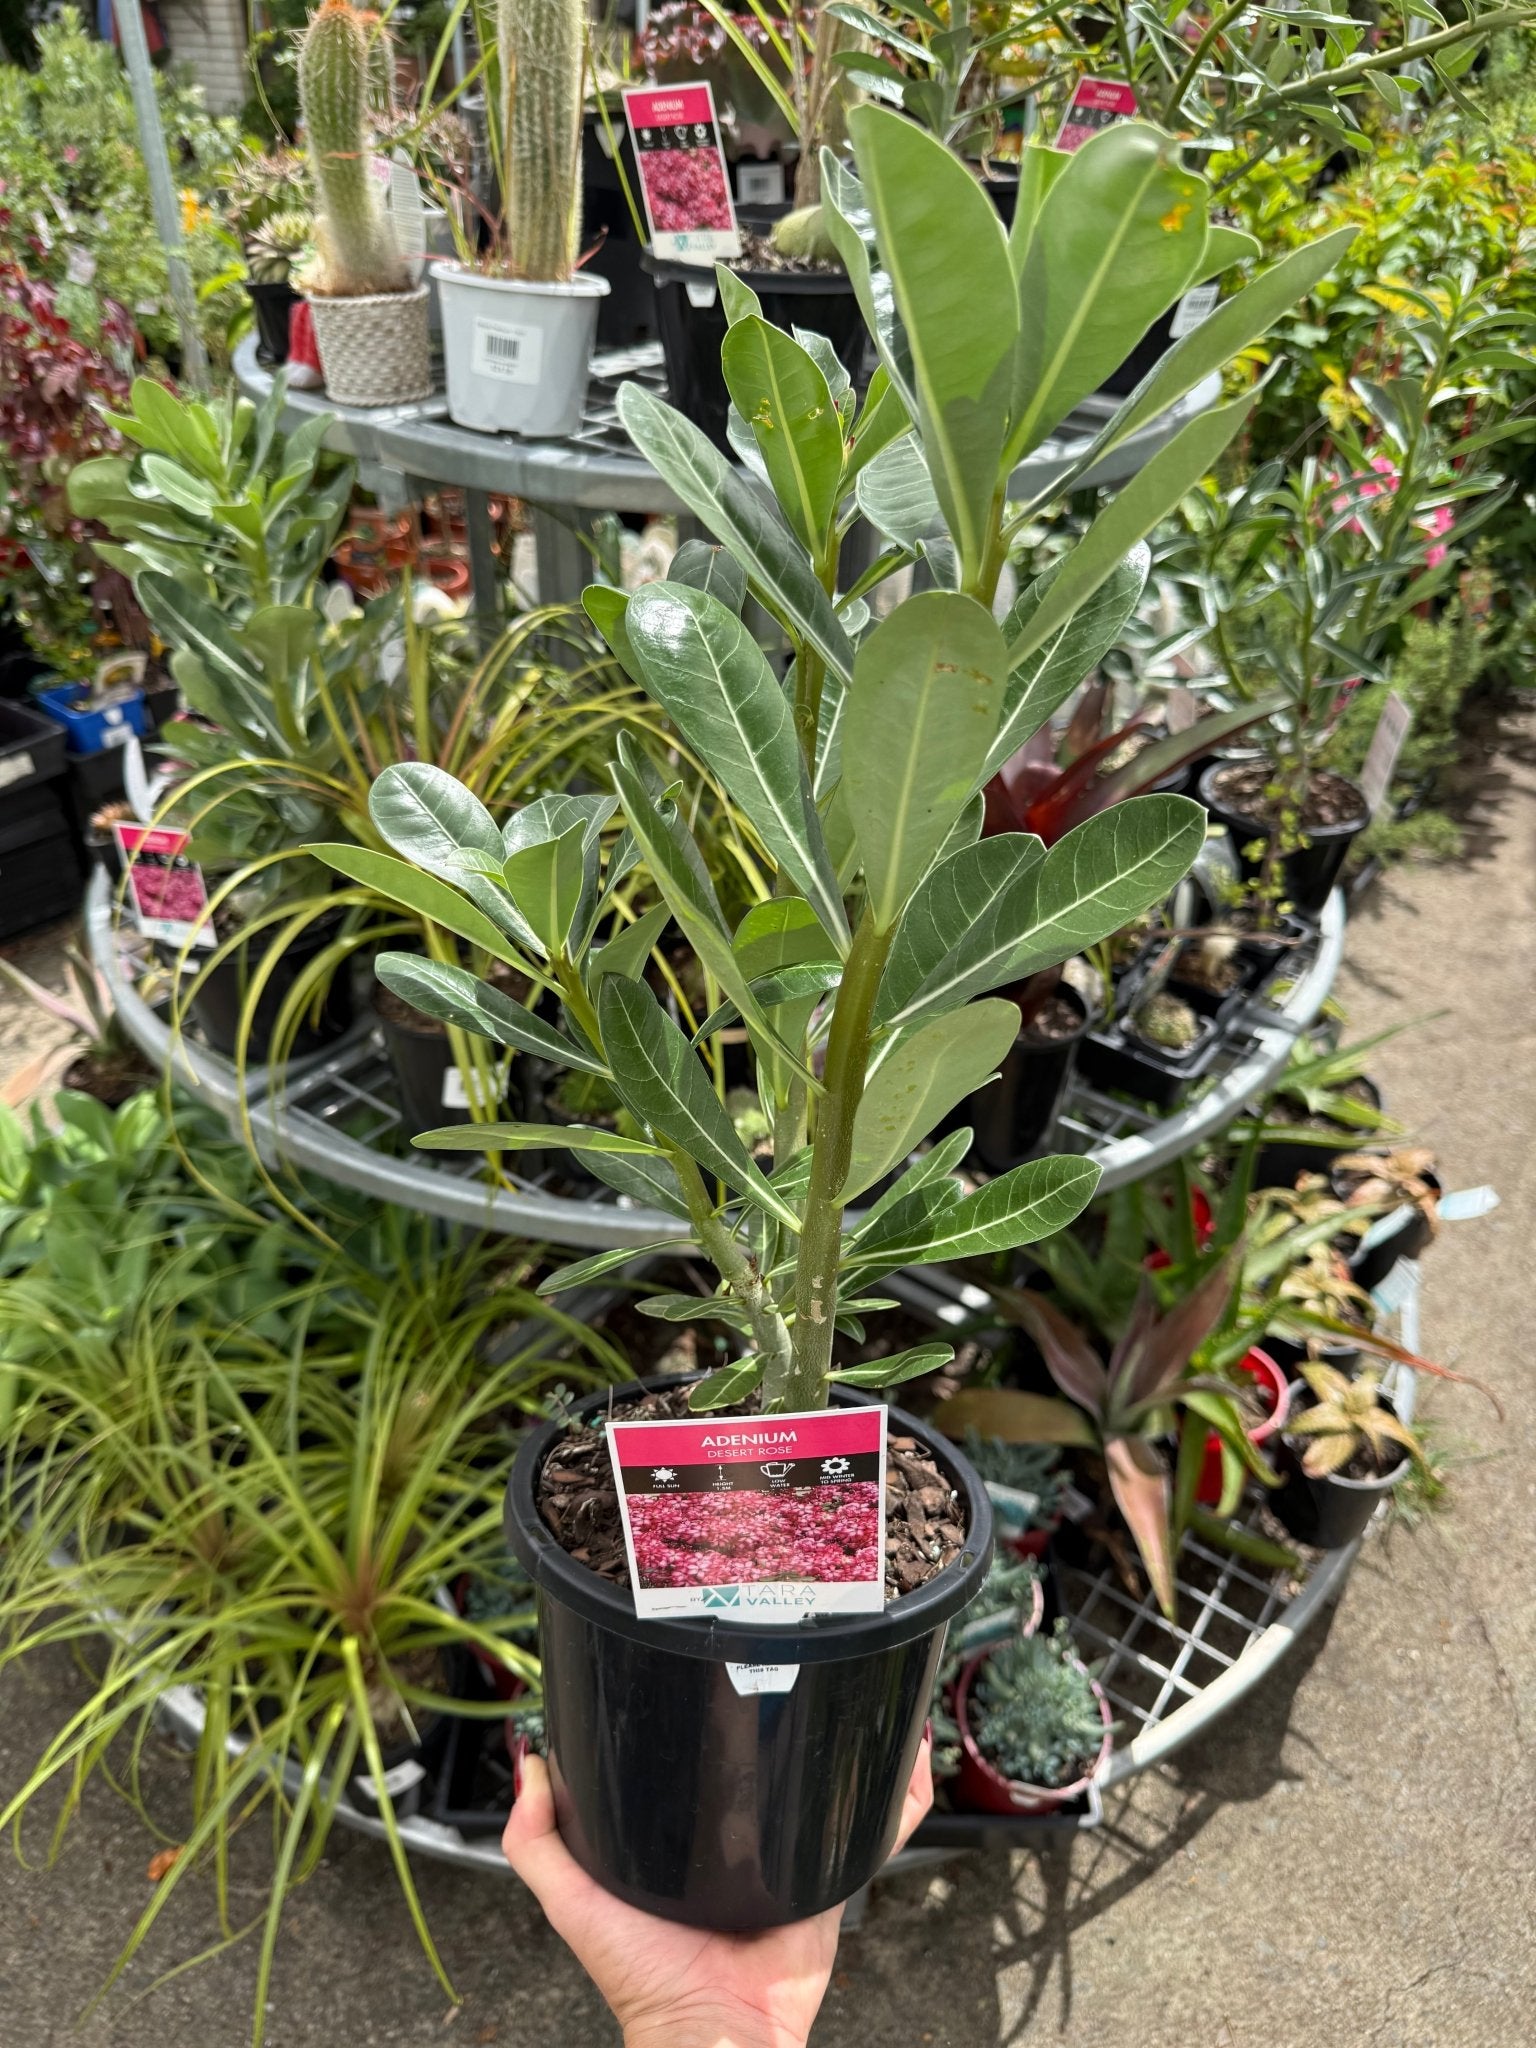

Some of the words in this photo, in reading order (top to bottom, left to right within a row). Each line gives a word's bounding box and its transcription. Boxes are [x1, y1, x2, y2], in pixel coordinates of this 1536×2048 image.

[701, 1431, 798, 1448] ADENIUM
[707, 1448, 753, 1458] DESERT
[758, 1446, 793, 1456] ROSE
[746, 1584, 816, 1596] TARA
[746, 1597, 816, 1605] VALLEY
